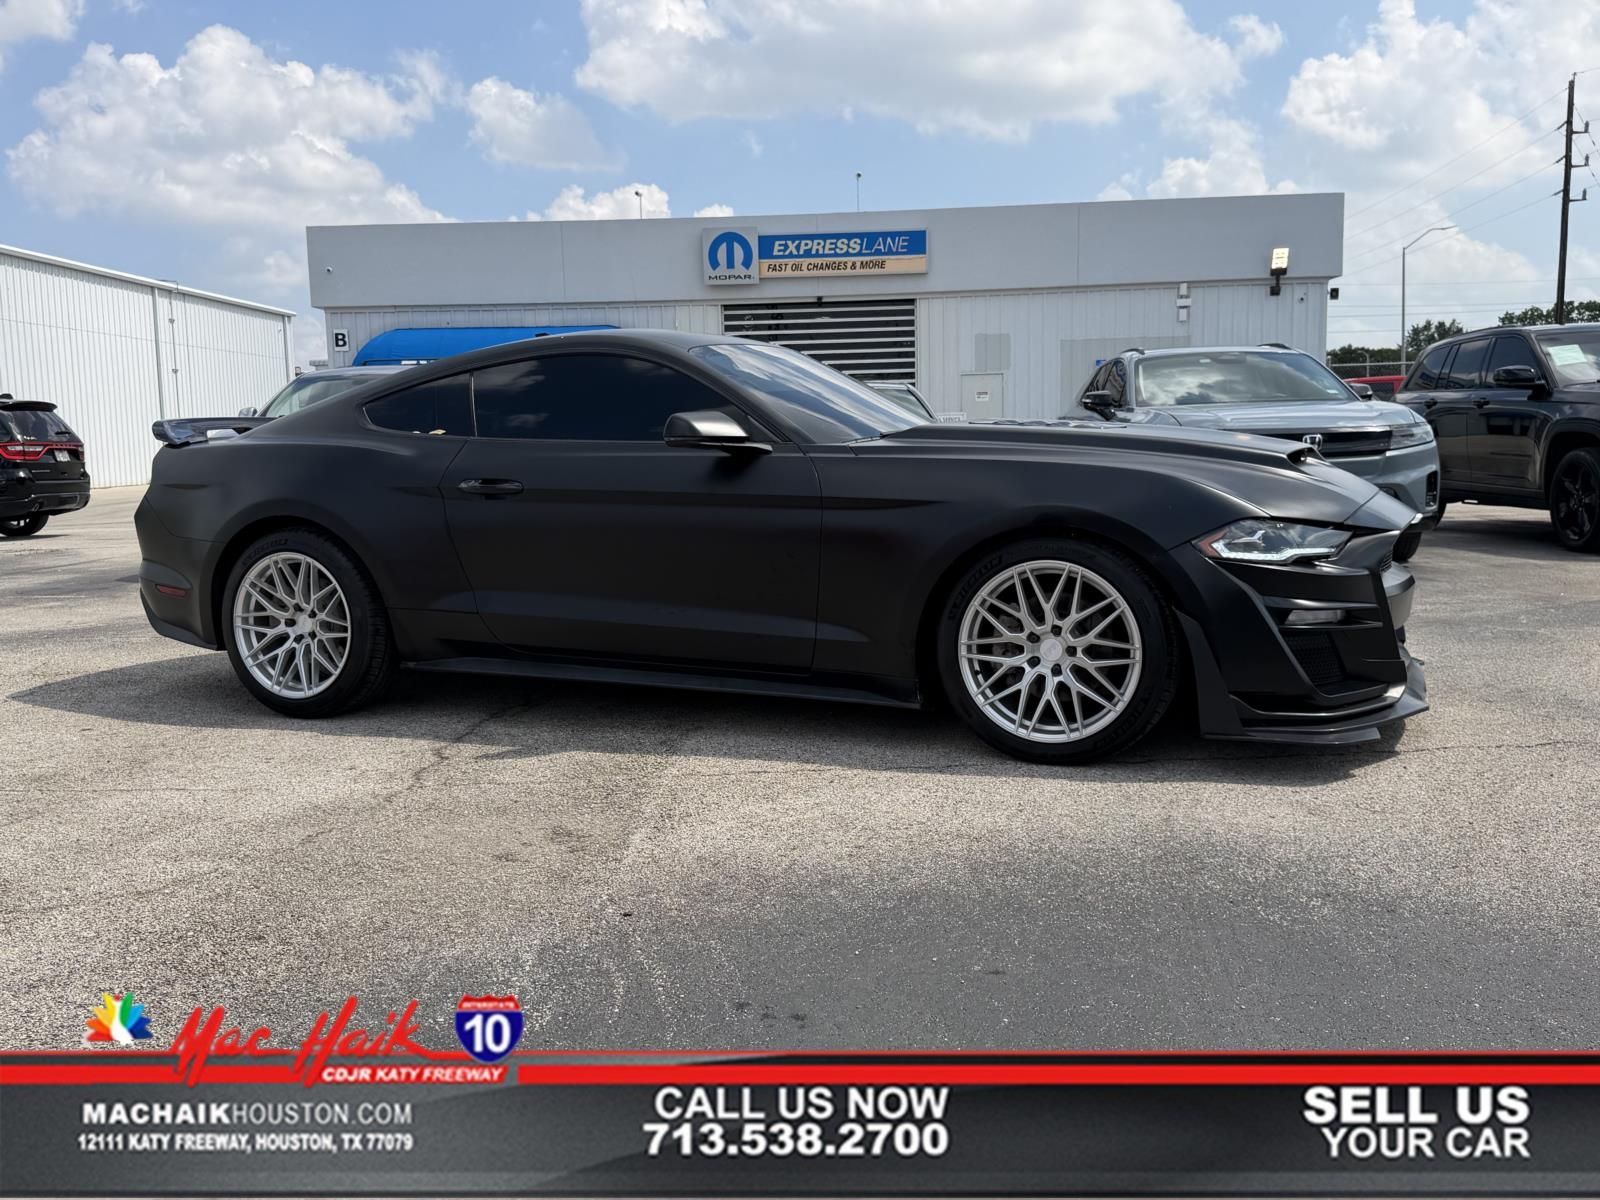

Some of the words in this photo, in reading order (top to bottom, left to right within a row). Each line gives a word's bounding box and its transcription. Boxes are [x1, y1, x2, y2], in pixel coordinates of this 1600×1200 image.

[767, 263, 787, 272] FAST
[790, 262, 804, 272] OIL
[807, 261, 848, 271] CHANGES
[850, 261, 857, 270] &
[859, 260, 887, 270] MORE
[334, 333, 347, 347] B
